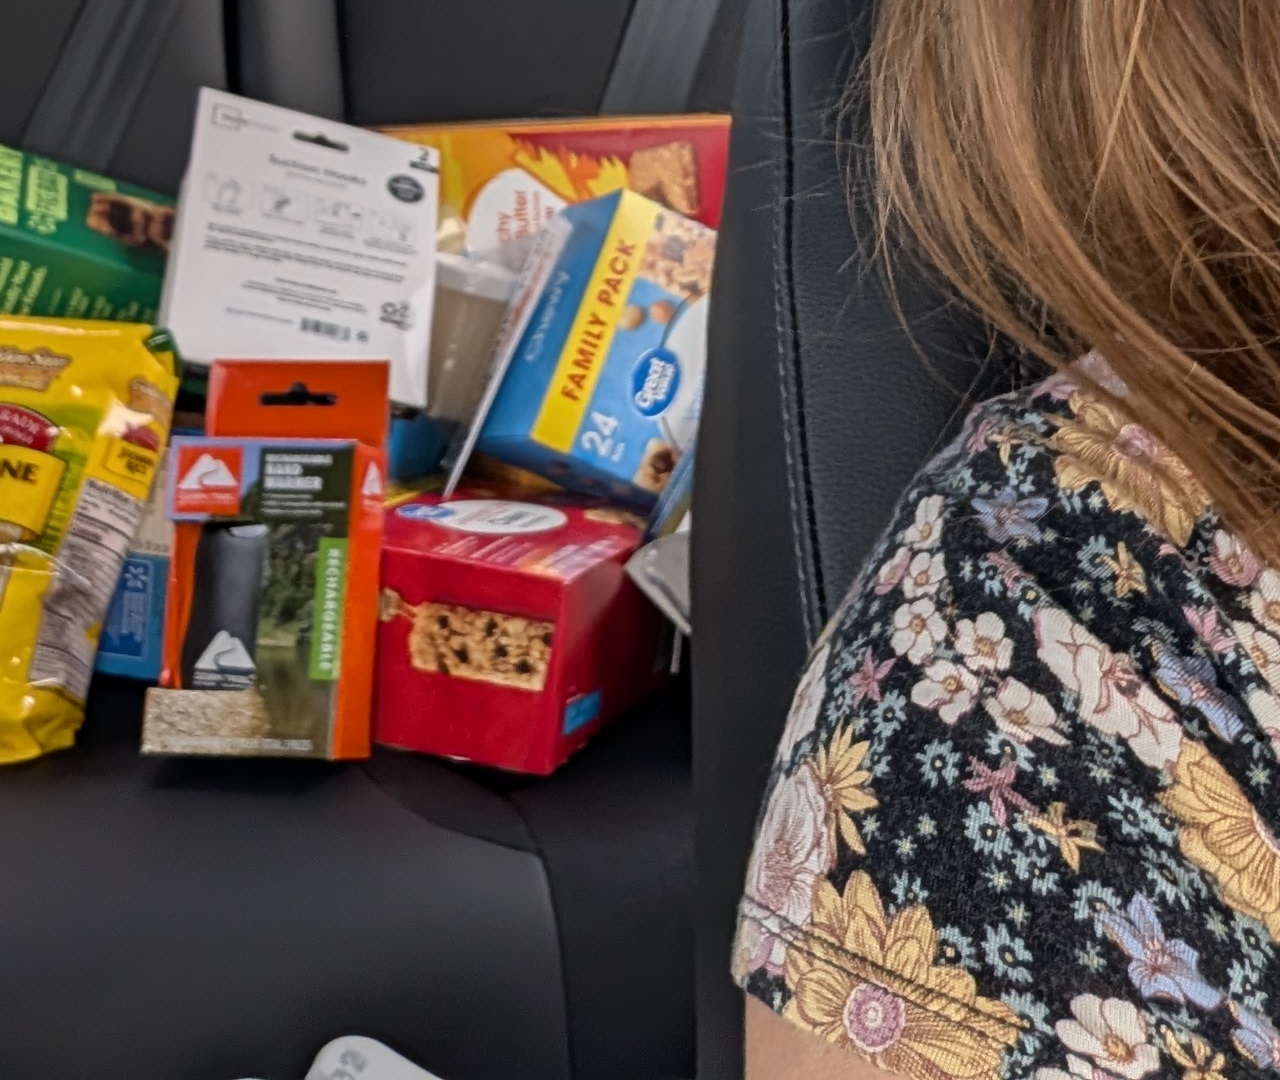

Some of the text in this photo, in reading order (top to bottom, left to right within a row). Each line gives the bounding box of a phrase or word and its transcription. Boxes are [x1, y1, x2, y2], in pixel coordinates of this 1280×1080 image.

[525, 271, 570, 361] Chewy
[559, 239, 637, 402] FAMILY PACK
[633, 354, 665, 407] Great
[651, 360, 675, 401] Value
[580, 410, 619, 460] 24
[318, 548, 341, 671] RECHARGEABLE
